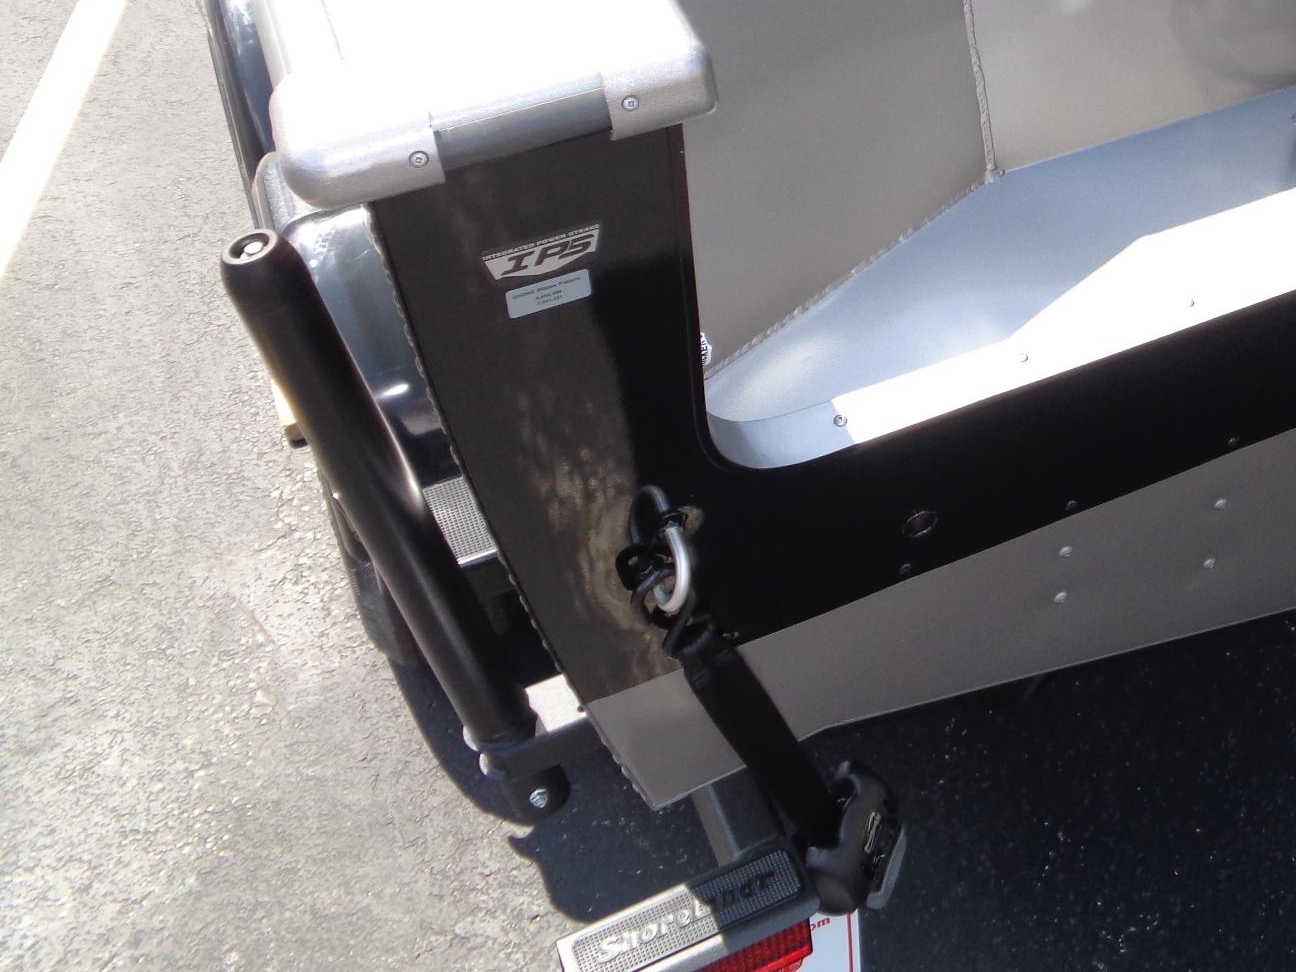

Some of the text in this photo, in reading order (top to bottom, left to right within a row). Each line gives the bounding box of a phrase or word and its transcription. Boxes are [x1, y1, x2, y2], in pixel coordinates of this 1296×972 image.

[482, 243, 535, 261] INTEGRATED
[536, 233, 566, 246] POWER
[501, 233, 595, 277] IPS
